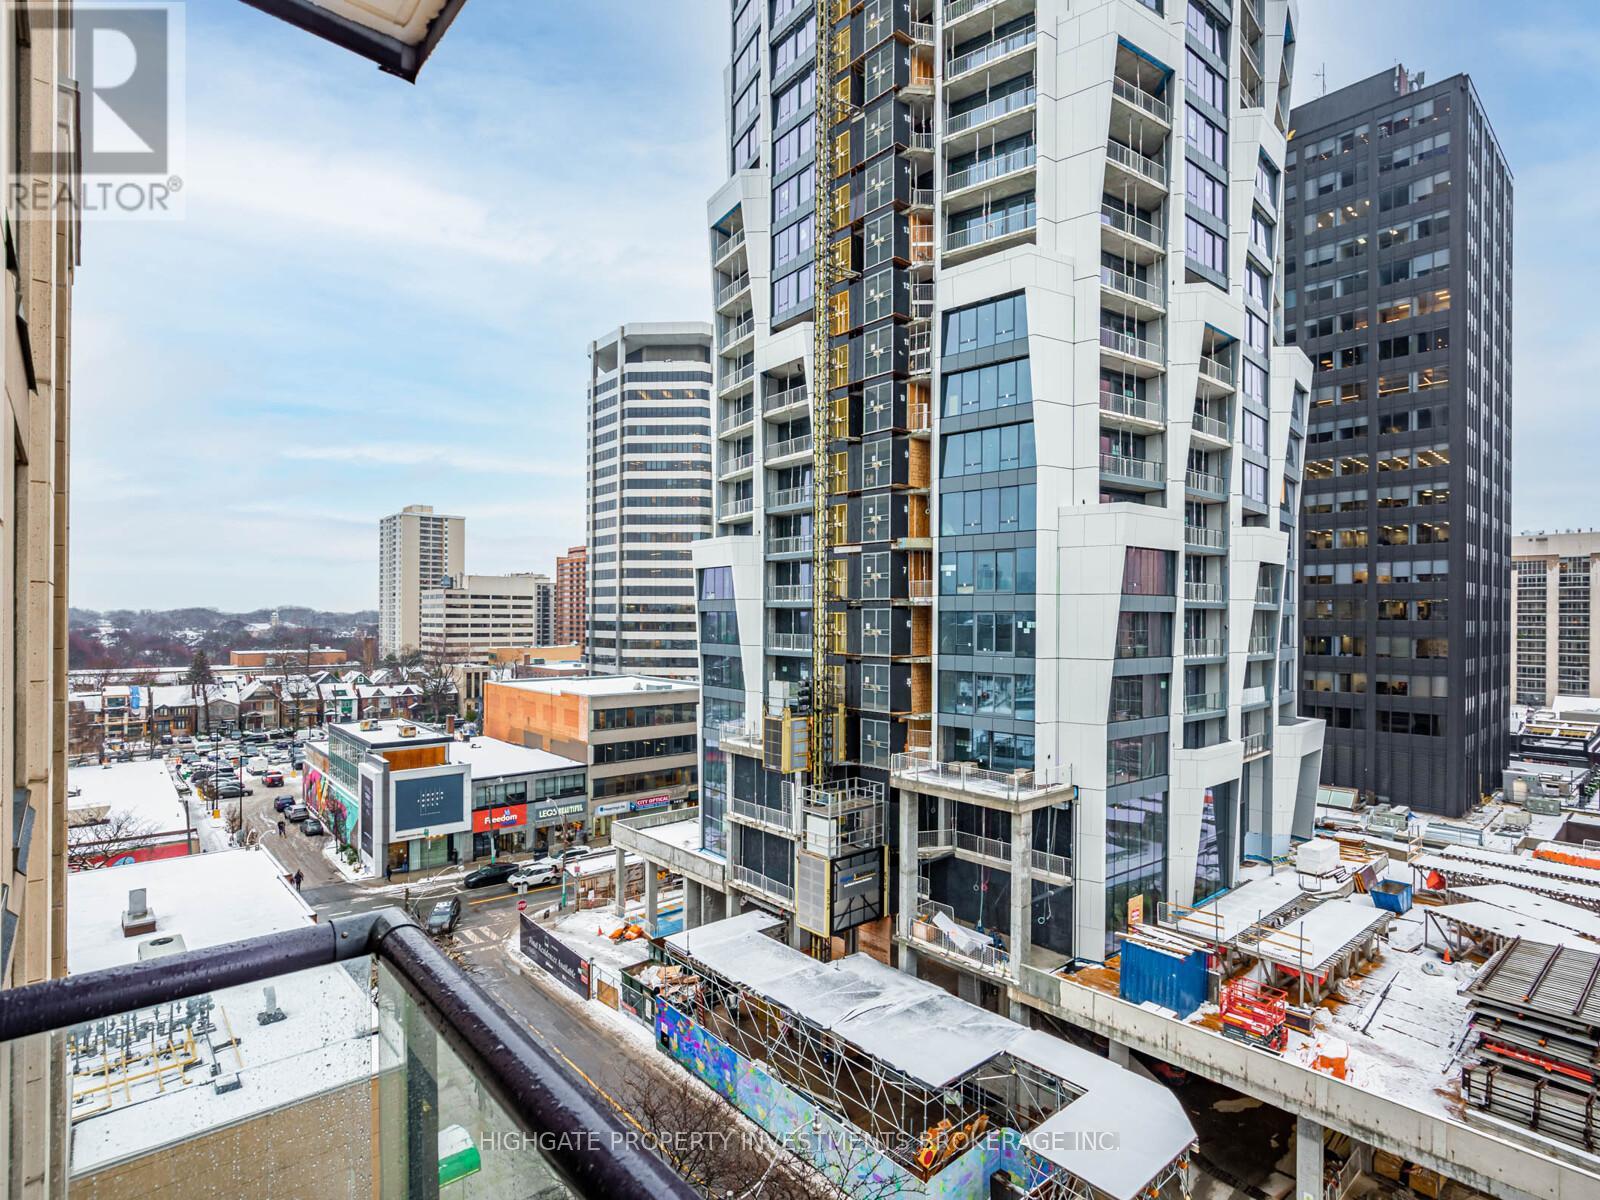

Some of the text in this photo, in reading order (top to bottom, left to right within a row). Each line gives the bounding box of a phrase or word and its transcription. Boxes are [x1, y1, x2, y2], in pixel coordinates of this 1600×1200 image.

[902, 281, 910, 290] 12
[902, 566, 907, 574] 7
[538, 809, 557, 818] LEGS
[484, 814, 518, 825] Freedom
